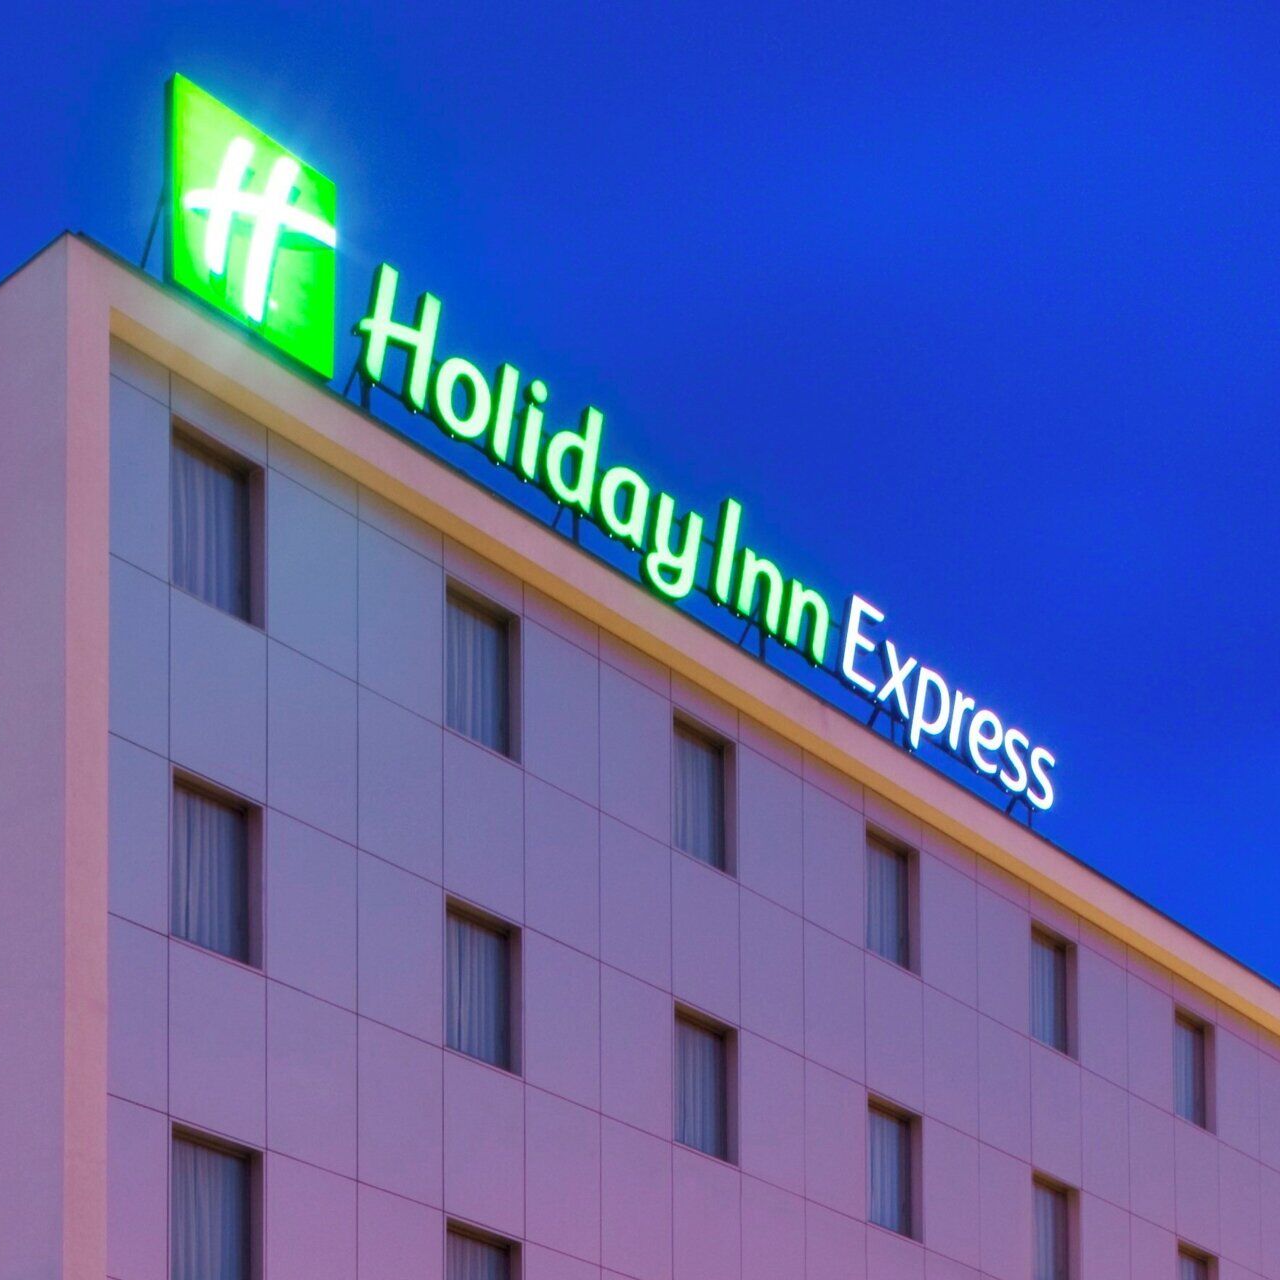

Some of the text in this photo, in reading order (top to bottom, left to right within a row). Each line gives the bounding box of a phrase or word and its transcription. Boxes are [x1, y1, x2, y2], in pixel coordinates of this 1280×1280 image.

[357, 262, 1056, 812] Holiday Inn Express
